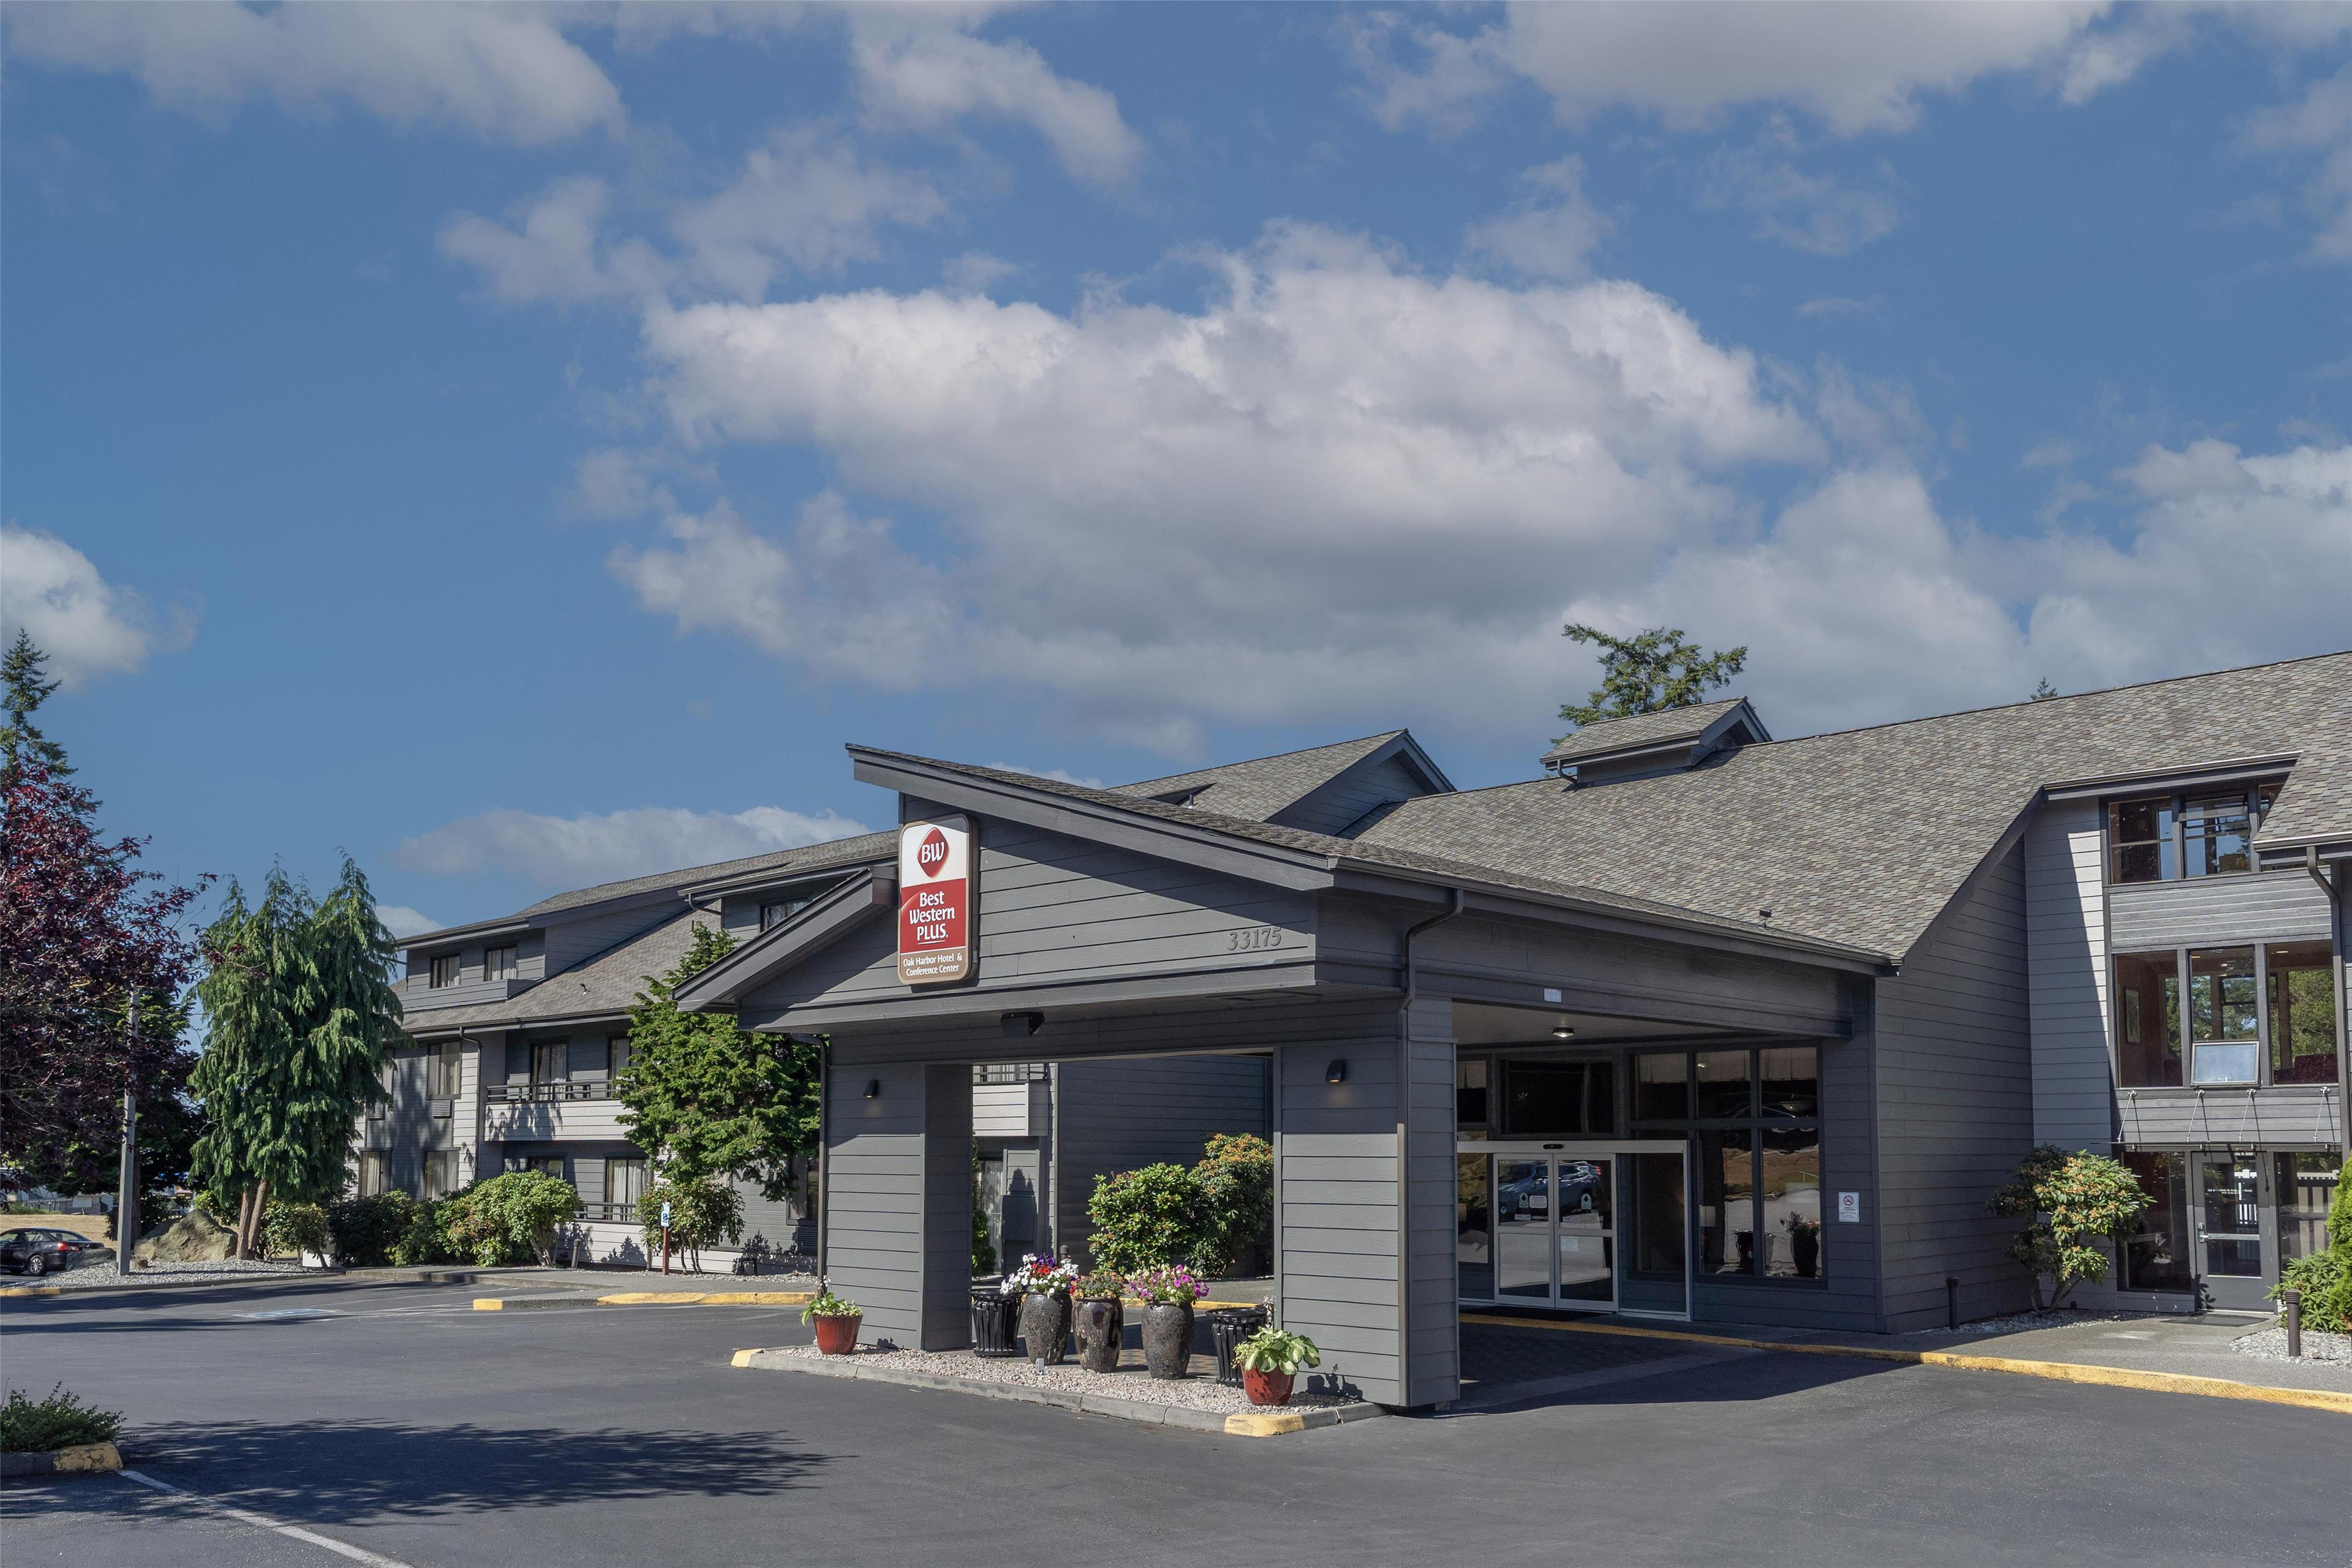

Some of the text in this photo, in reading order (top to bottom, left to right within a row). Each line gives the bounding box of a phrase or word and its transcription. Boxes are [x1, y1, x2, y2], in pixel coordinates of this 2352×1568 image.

[921, 842, 944, 864] BW
[919, 891, 945, 907] Best
[909, 907, 955, 925] Western
[1227, 925, 1282, 951] 33175
[916, 956, 937, 965] Harbor
[937, 953, 954, 963] Hotel
[957, 952, 962, 961] &
[906, 965, 959, 976] Conference Center
